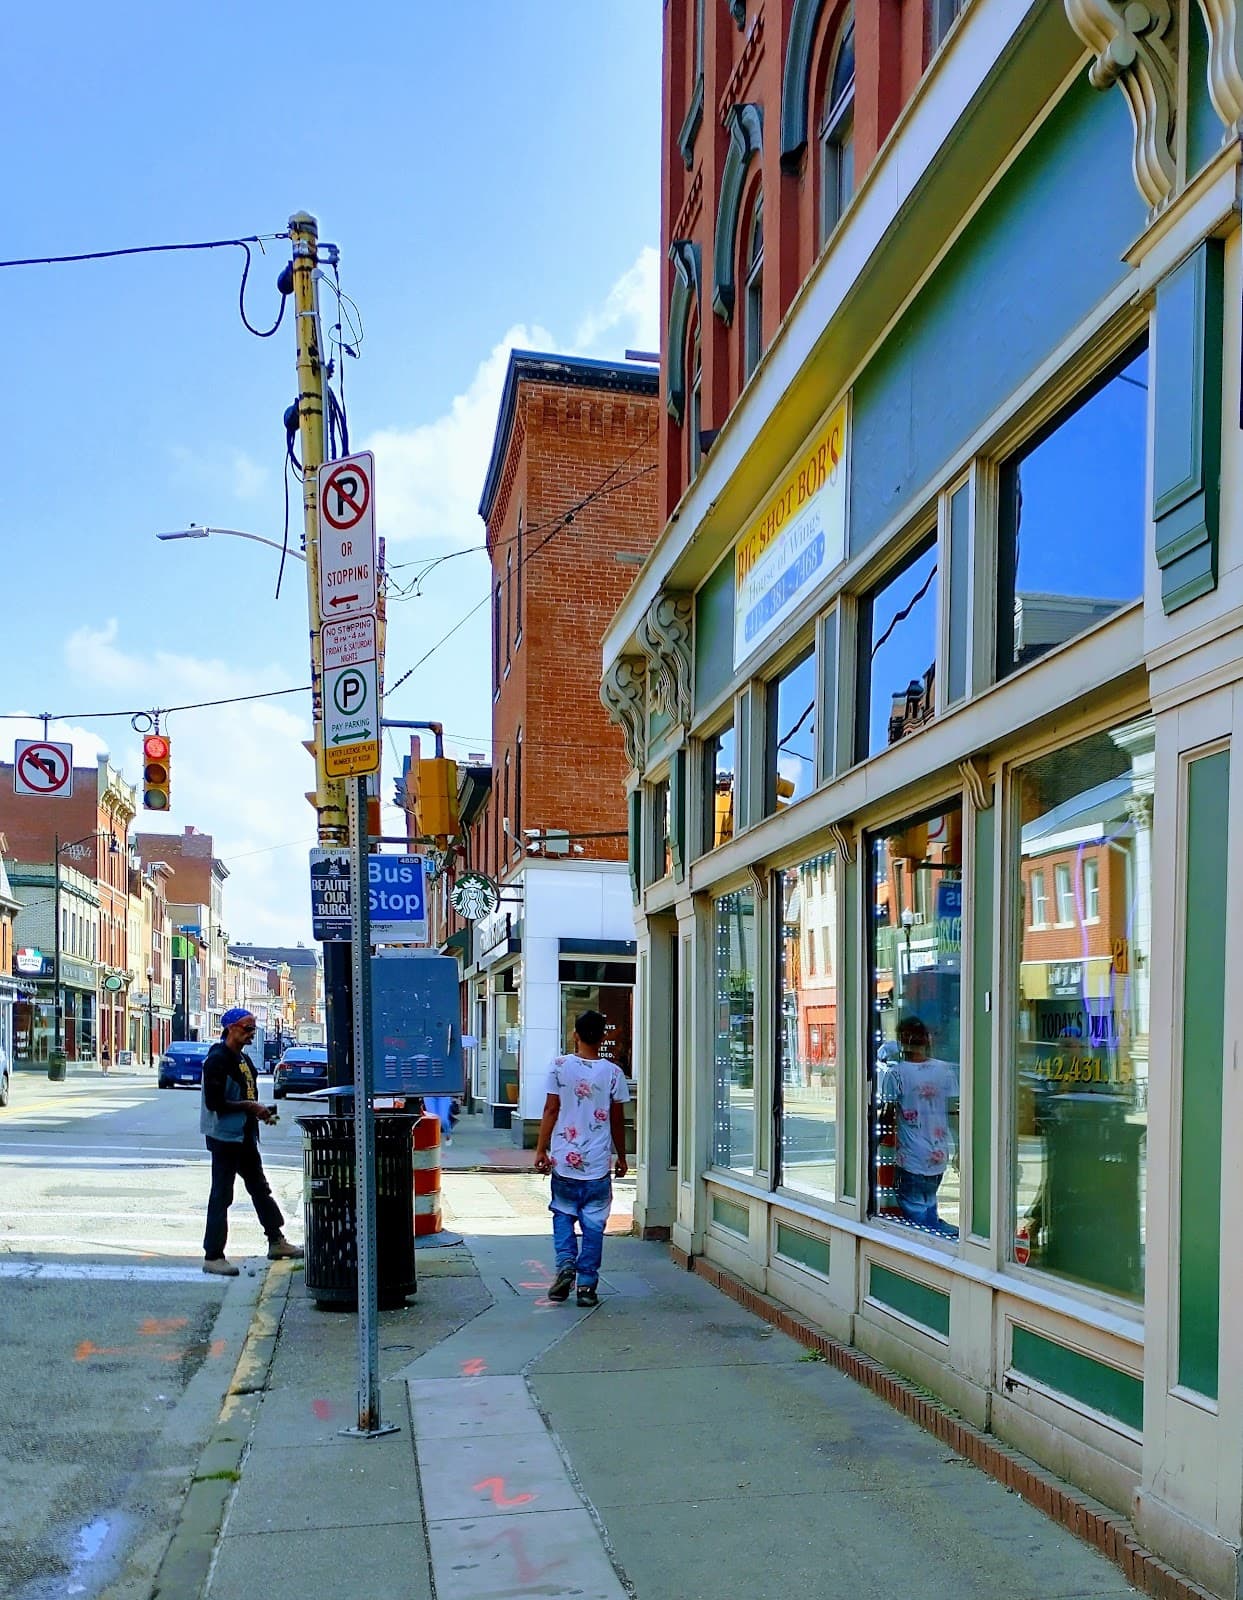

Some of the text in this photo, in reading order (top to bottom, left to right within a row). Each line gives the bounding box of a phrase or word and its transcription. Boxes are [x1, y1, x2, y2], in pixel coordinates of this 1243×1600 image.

[758, 483, 795, 553] SHOT
[797, 424, 840, 505] BOB'S
[341, 541, 353, 557] OR
[748, 513, 820, 602] House of Wings
[327, 564, 369, 587] STOPPING
[769, 585, 785, 617] 381
[795, 545, 817, 590] 7468
[326, 619, 371, 636] NO STOPPING
[325, 646, 343, 656] FRIDAY
[348, 639, 373, 651] SATURDAY
[340, 652, 358, 663] NIGHTS
[331, 718, 370, 732] PAY PARKING
[368, 862, 413, 883] Bus
[324, 891, 346, 903] OUR
[369, 888, 420, 915] Stop
[1041, 1012, 1083, 1039] TODAY'S
